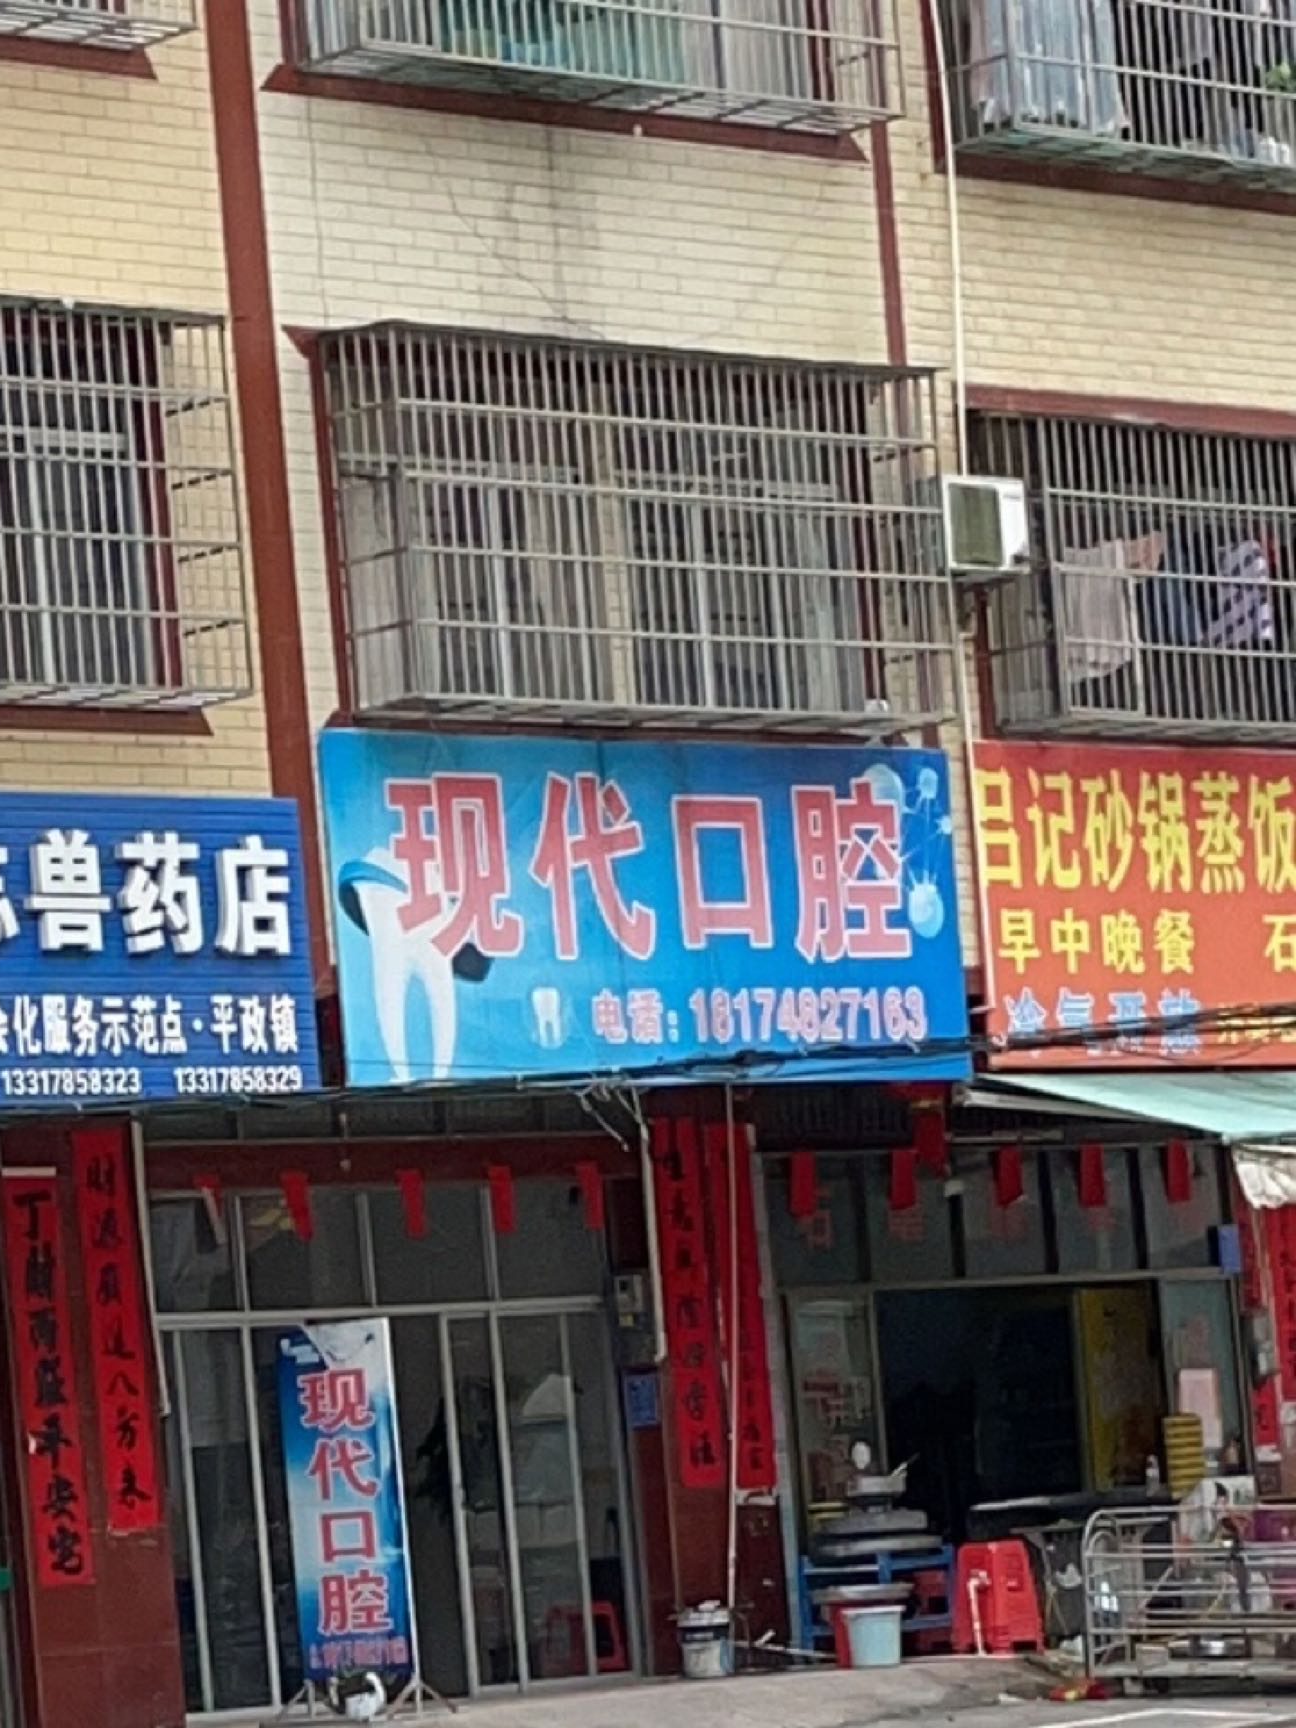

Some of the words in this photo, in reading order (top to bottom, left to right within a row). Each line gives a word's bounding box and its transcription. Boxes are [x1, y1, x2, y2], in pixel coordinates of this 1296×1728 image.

[384, 771, 912, 963] 现代口腔
[998, 907, 1196, 975] 早中晚餐
[297, 1367, 395, 1635] 现代口腔
